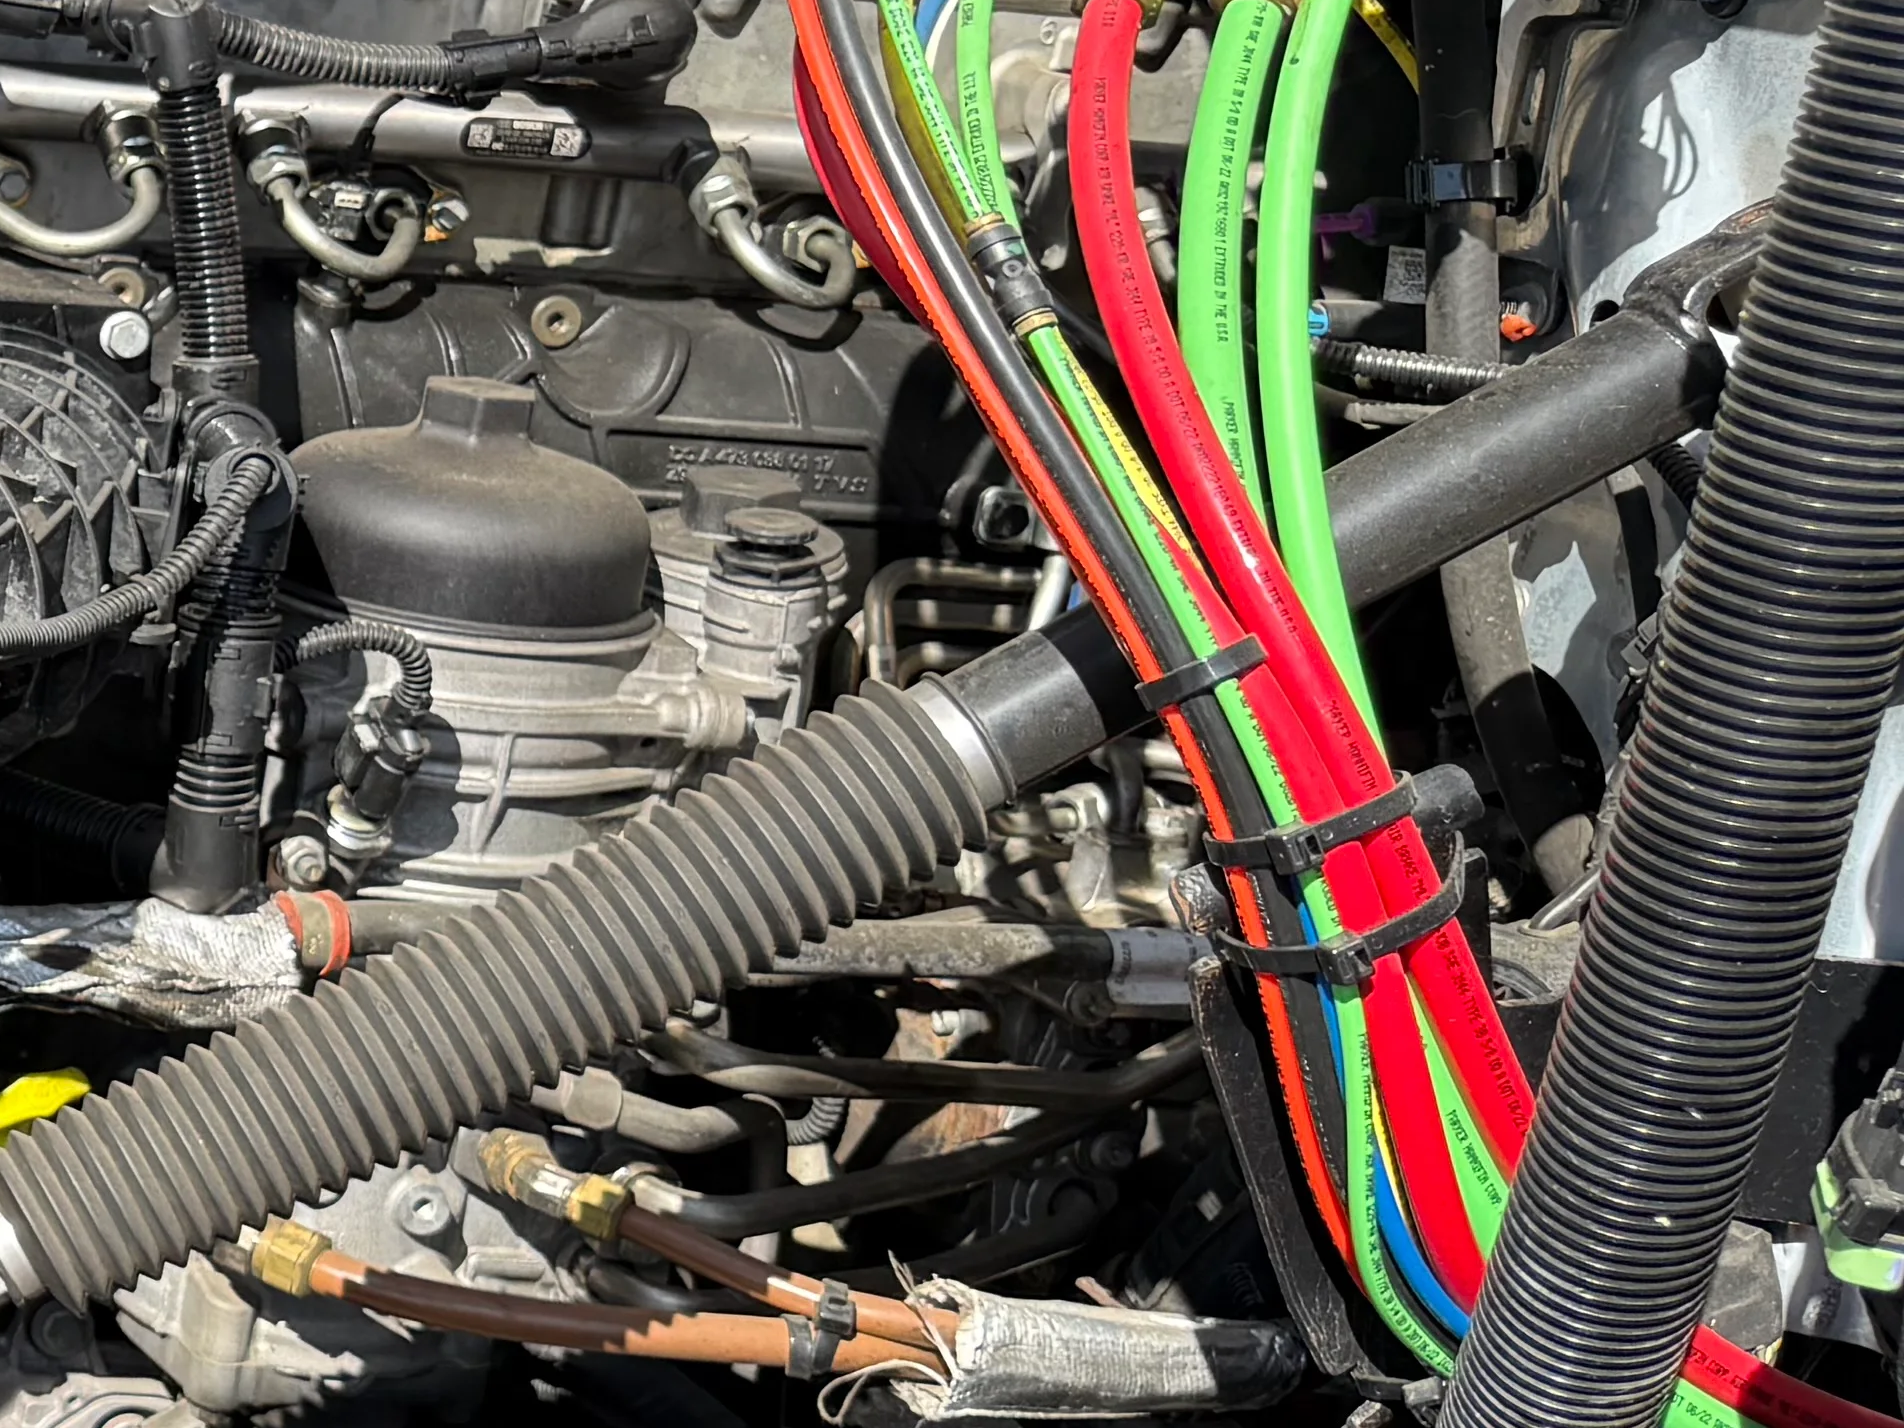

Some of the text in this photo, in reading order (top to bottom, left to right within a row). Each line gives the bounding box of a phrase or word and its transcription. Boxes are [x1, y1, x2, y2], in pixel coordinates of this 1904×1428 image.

[1214, 245, 1228, 288] EXTRUDED
[1214, 303, 1228, 320] THE
[1166, 389, 1186, 407] DOT
[1223, 400, 1239, 433] PARKER
[1462, 995, 1484, 1027] TYPE
[1445, 1108, 1492, 1190] PARKER HANNIFIN
[1685, 1402, 1710, 1426] 06/22
